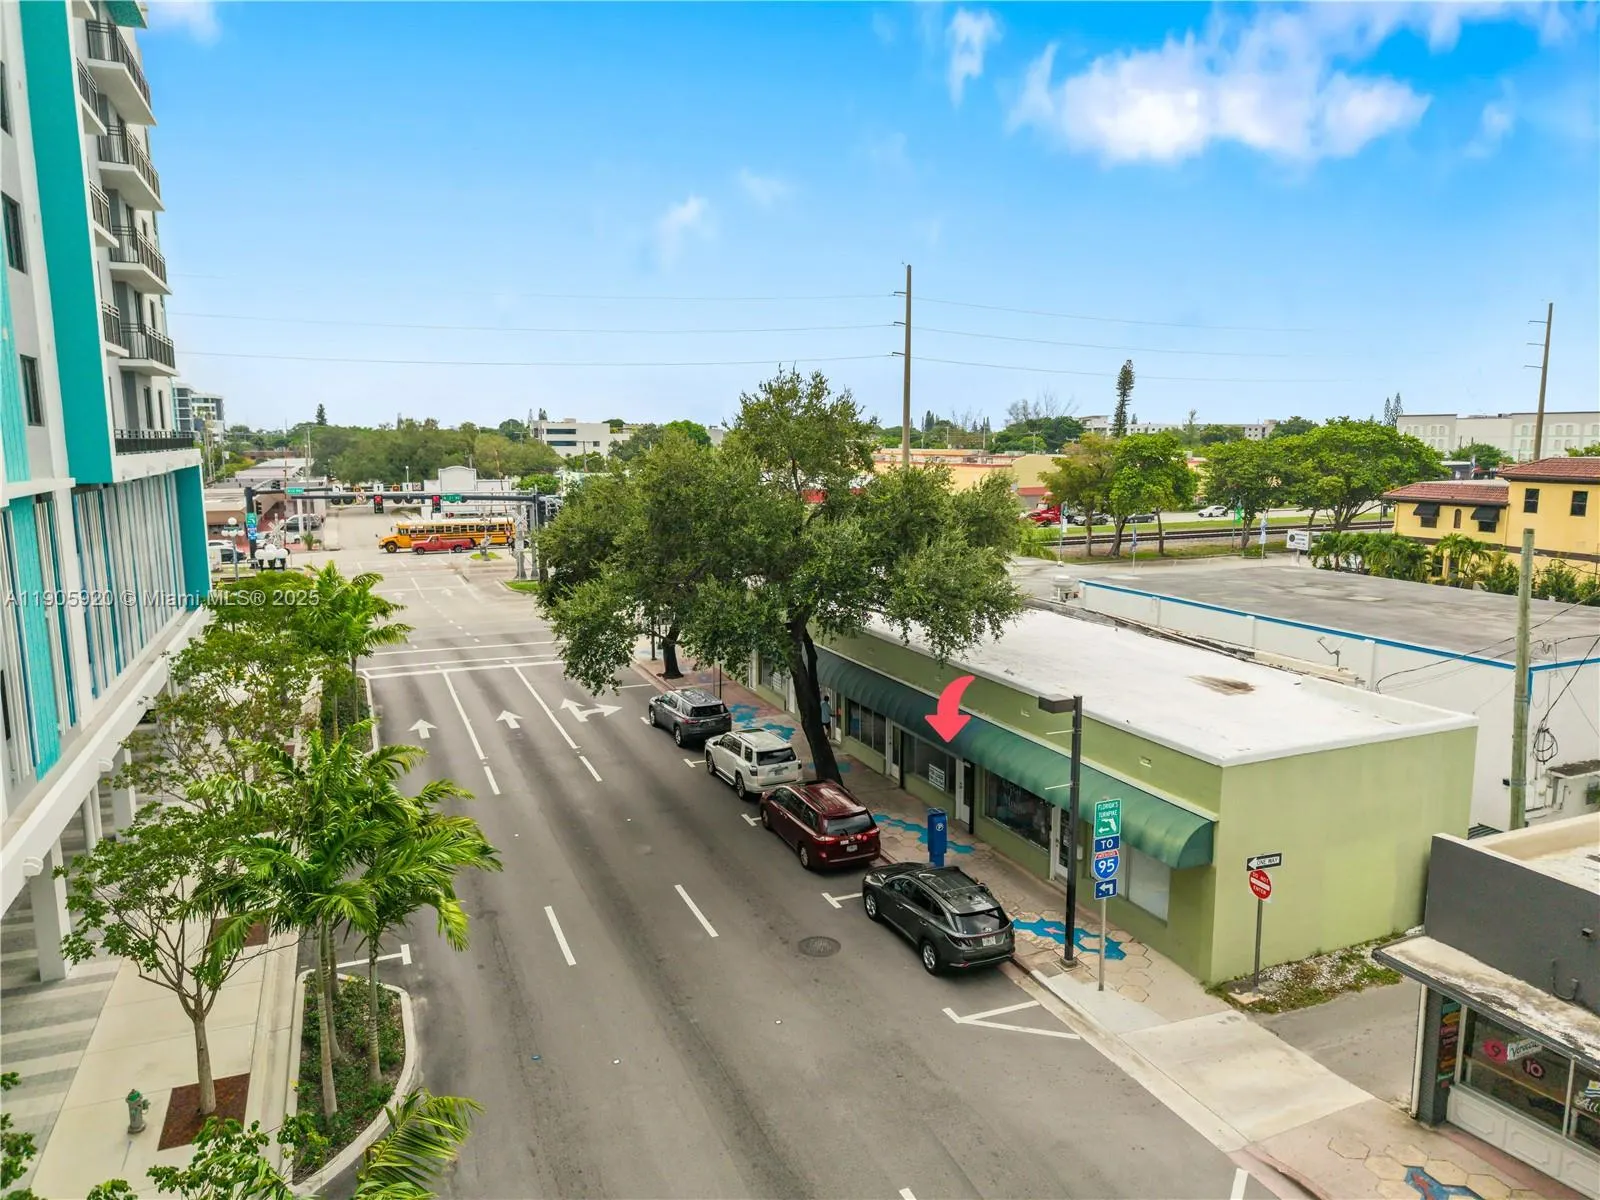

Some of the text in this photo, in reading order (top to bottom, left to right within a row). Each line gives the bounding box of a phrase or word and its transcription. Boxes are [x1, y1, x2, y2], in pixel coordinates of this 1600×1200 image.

[1098, 809, 1118, 818] TURNPIKE
[1101, 839, 1114, 849] TO
[1098, 858, 1115, 874] 95
